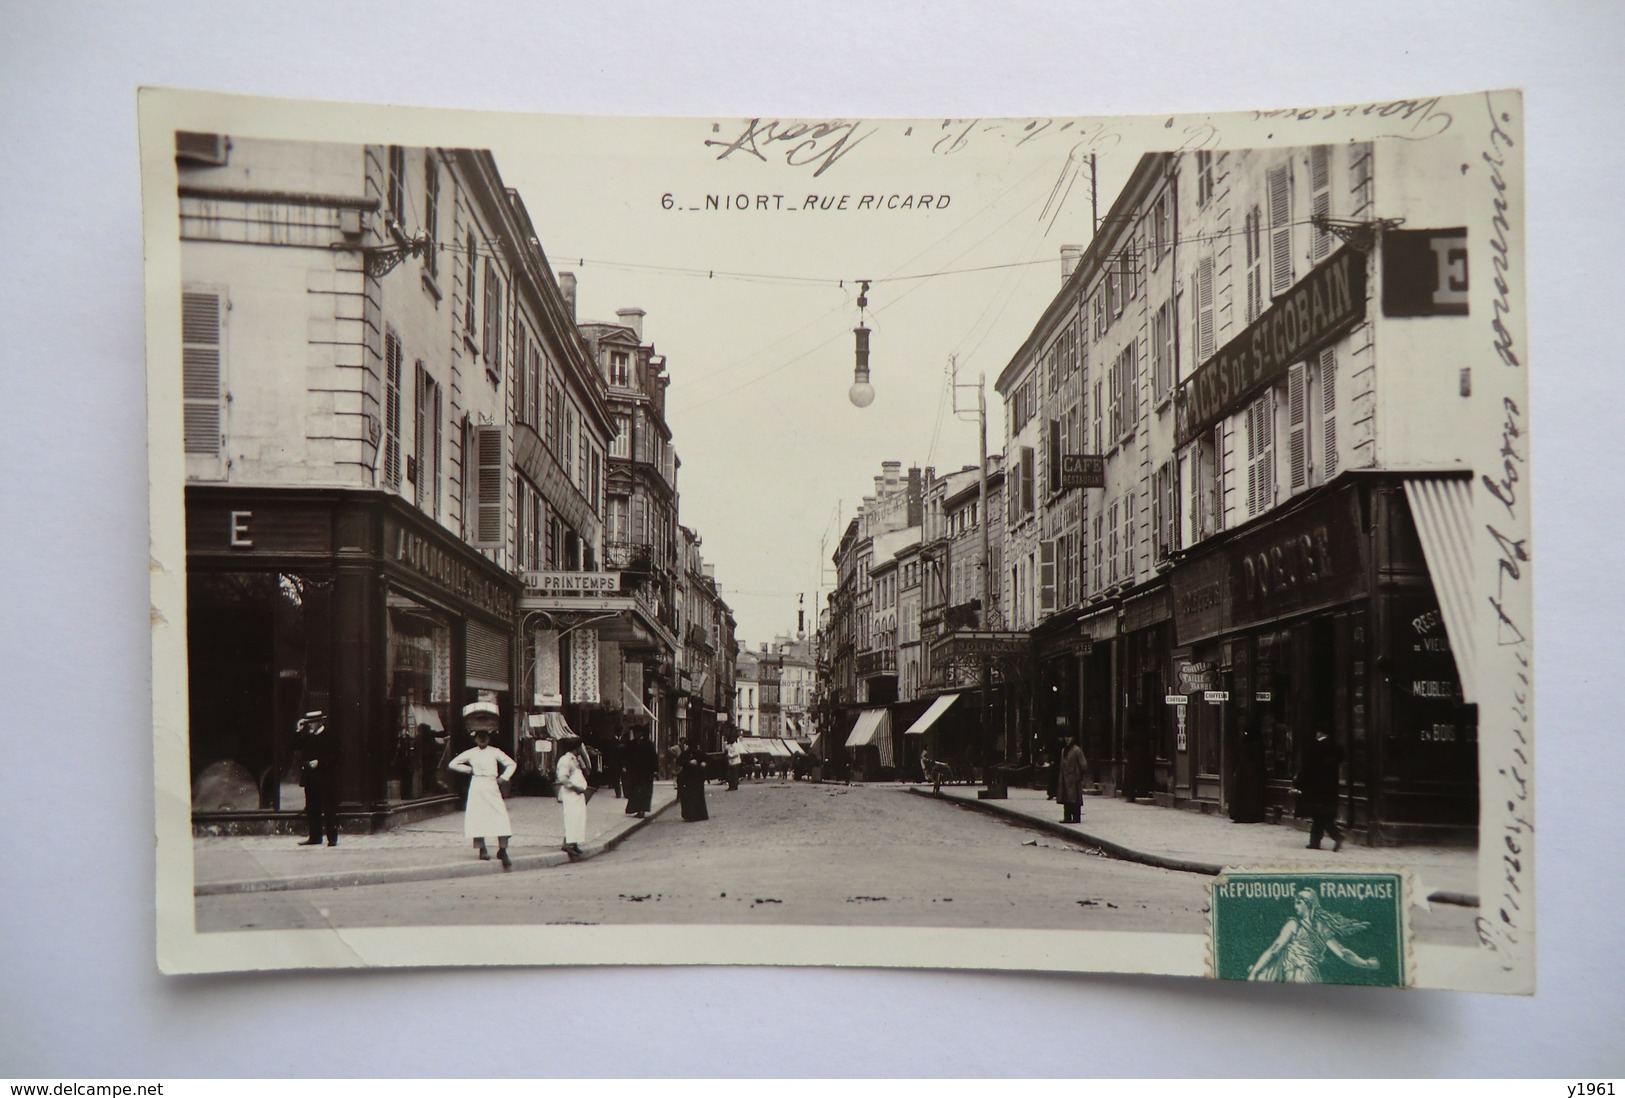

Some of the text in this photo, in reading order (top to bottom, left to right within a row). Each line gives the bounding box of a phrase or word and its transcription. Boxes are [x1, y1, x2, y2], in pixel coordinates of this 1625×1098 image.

[802, 194, 850, 210] RUE
[857, 194, 951, 210] RICARD
[1273, 255, 1352, 365] GOBAIN
[231, 511, 253, 547] E
[524, 576, 615, 589] AU PRINTEMPS
[1413, 681, 1452, 697] MEUBLES
[1433, 723, 1457, 742] BOIS
[1320, 882, 1393, 899] FRANÇAISE
